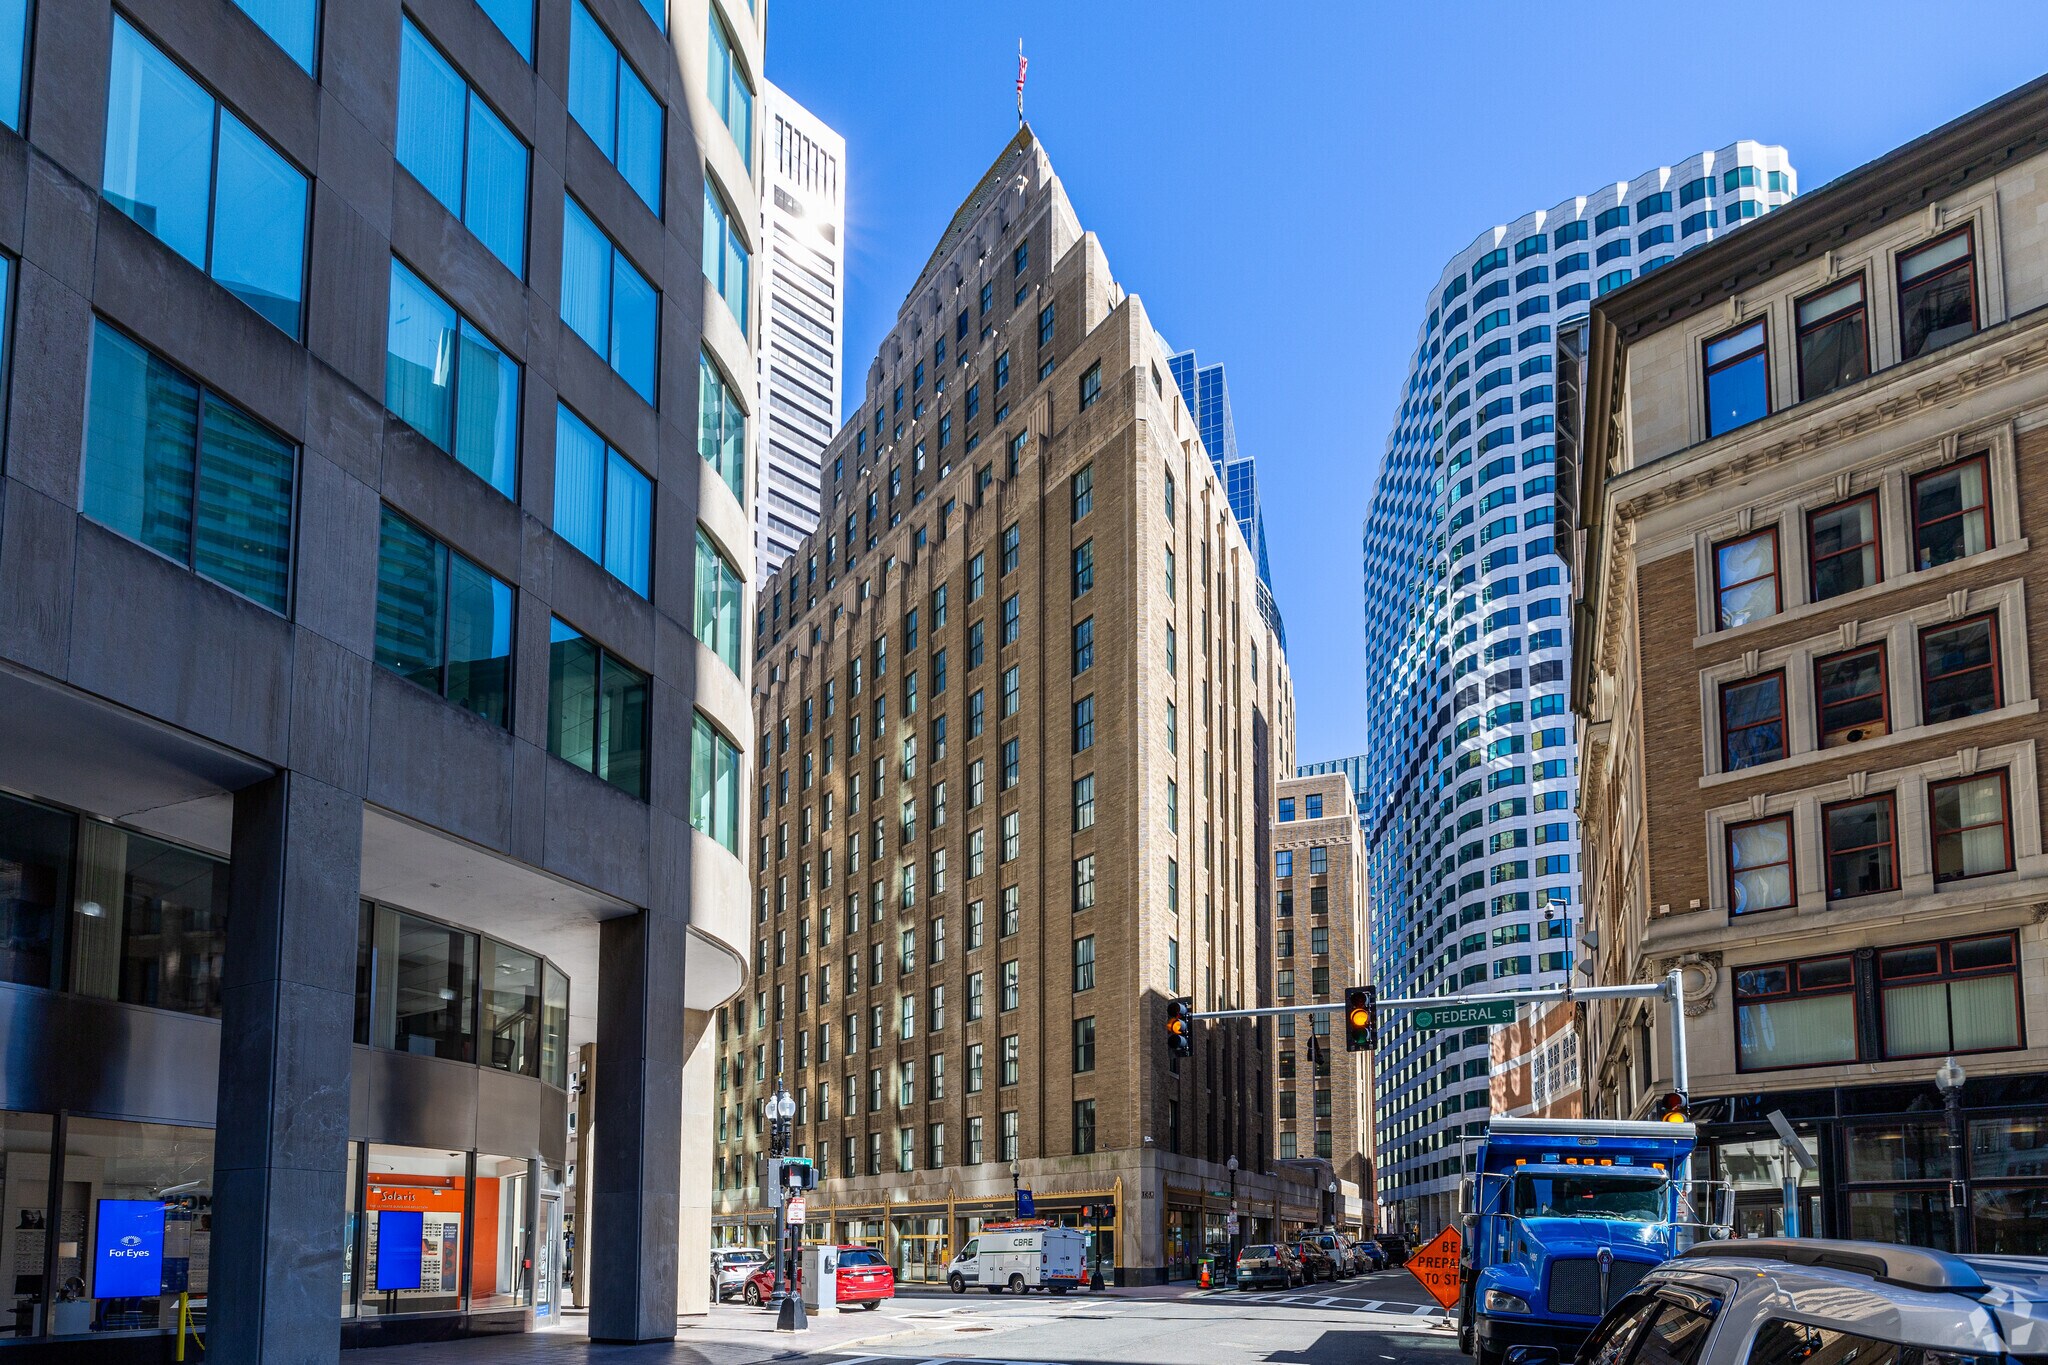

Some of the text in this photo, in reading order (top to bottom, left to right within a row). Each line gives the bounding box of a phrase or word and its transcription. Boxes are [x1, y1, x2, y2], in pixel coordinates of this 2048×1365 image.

[1435, 1007, 1513, 1024] FEDERAL ST
[381, 1191, 416, 1202] Solaris
[1013, 1238, 1034, 1247] CBRE
[1442, 1241, 1458, 1253] BE
[109, 1249, 150, 1258] For Eyes
[1425, 1272, 1458, 1286] TO ST
